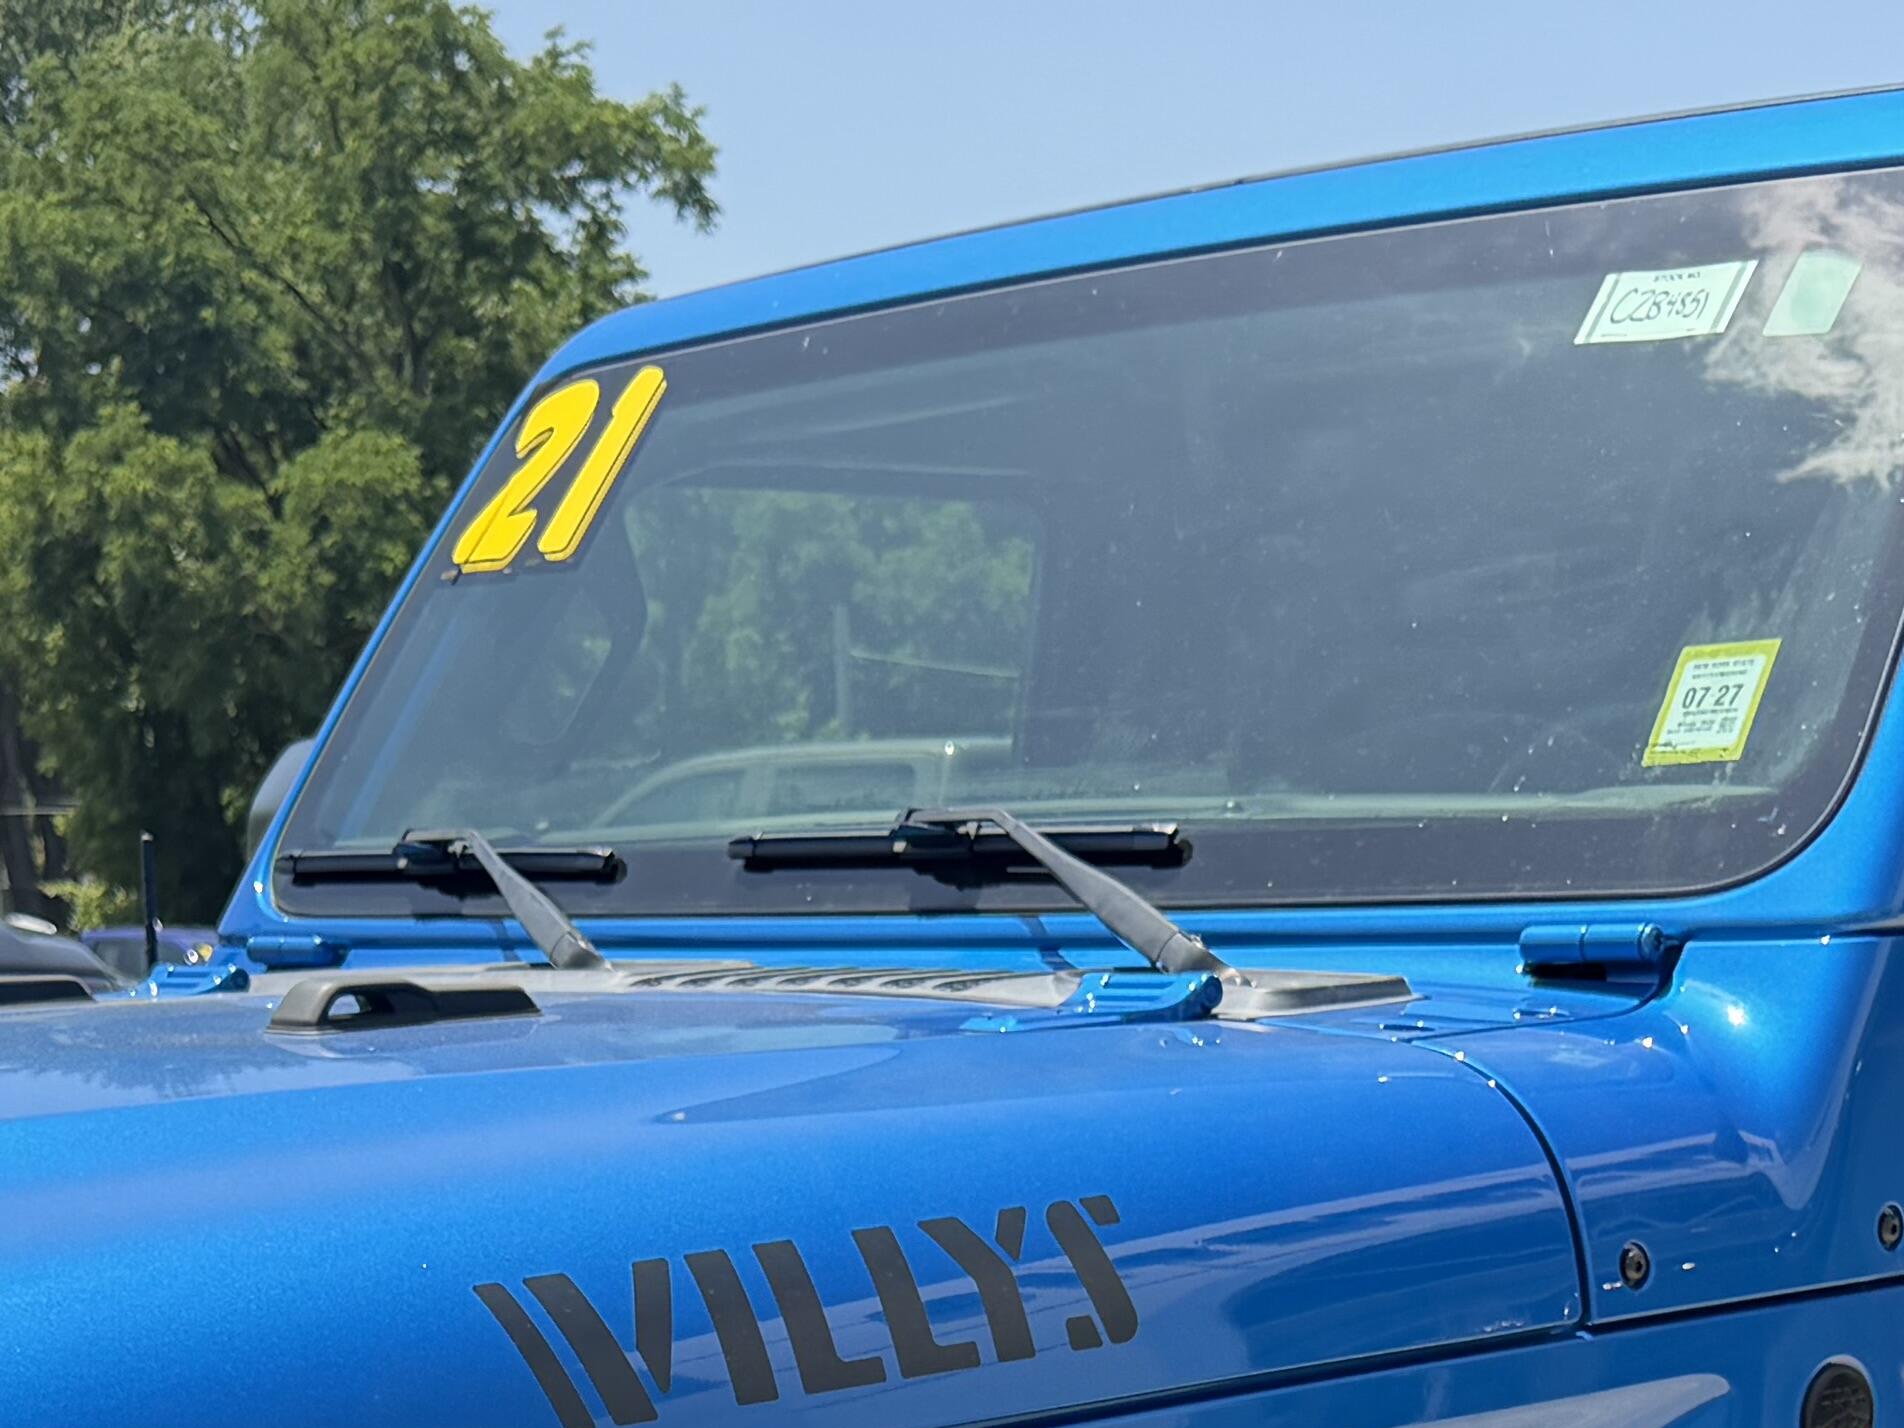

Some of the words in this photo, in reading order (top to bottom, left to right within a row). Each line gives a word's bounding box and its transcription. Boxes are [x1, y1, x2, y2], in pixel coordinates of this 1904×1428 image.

[451, 364, 668, 574] 21
[1682, 686, 1712, 709] 07
[1713, 683, 1745, 707] 27
